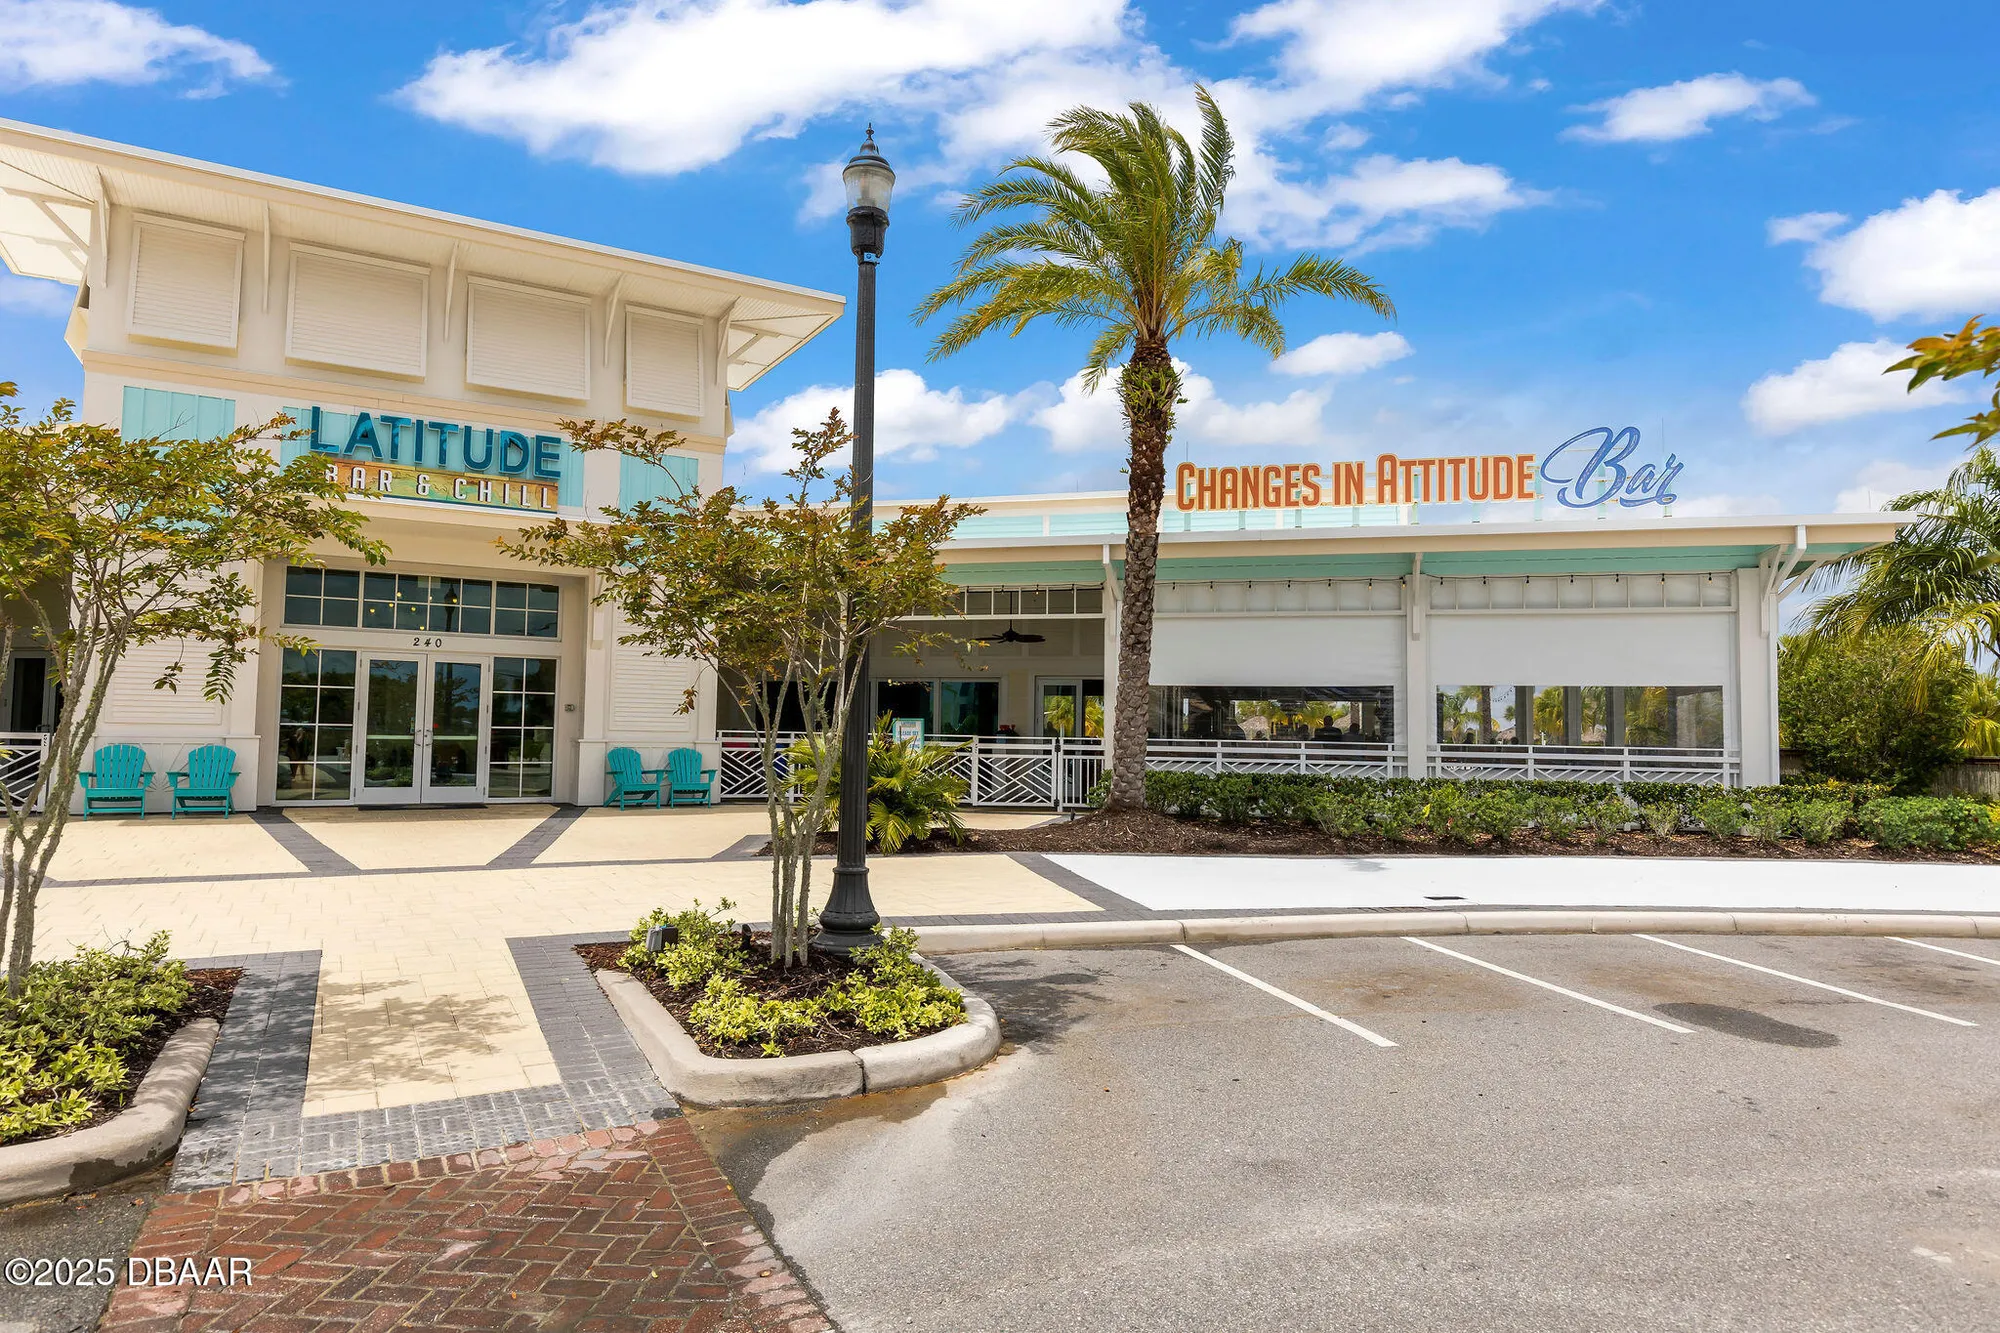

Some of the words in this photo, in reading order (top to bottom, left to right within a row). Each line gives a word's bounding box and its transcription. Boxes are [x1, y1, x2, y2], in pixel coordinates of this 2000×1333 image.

[310, 405, 562, 478] LATITUDE
[1176, 461, 1322, 513] CHANGES
[1332, 460, 1366, 506] IN
[1376, 452, 1538, 507] ATTITUDE
[1540, 426, 1684, 509] Bar
[324, 463, 393, 492] BAR
[415, 473, 430, 497] &
[453, 477, 551, 509] CHILL
[412, 637, 443, 649] 240
